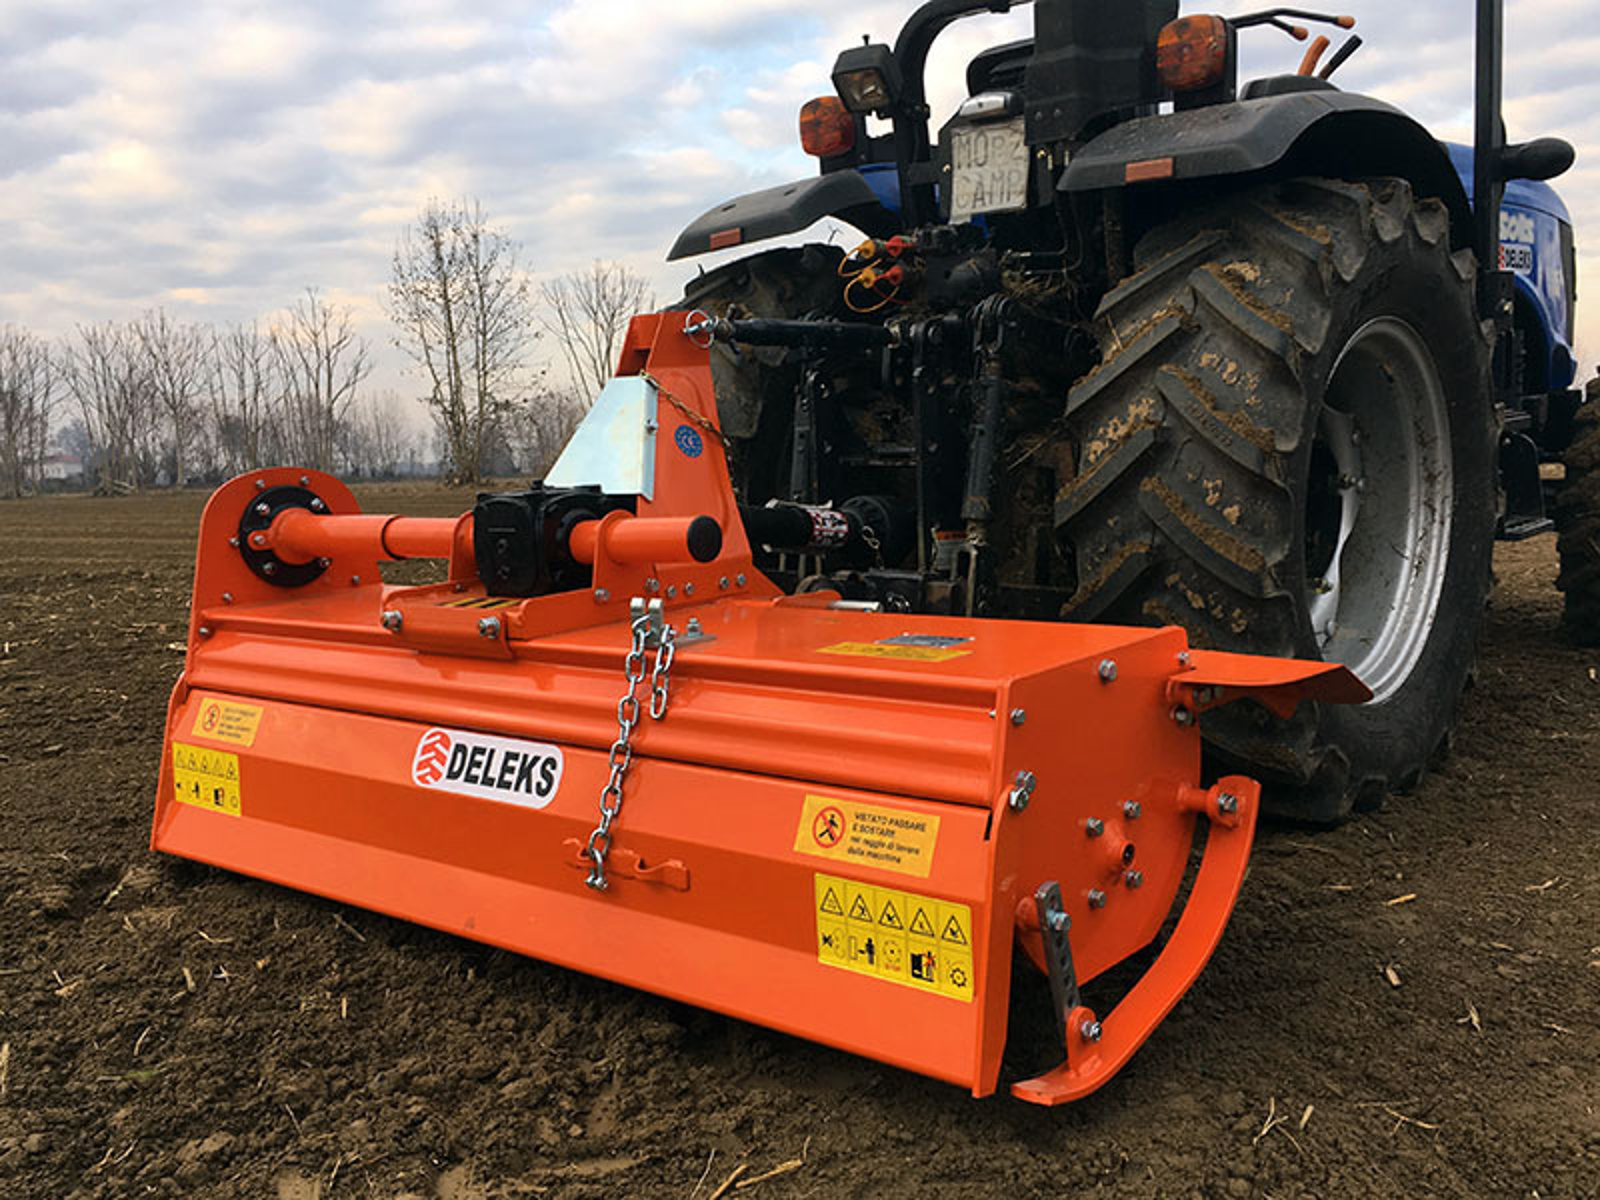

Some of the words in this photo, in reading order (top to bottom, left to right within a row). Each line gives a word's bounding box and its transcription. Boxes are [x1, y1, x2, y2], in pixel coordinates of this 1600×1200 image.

[446, 743, 557, 797] DELEKS
[854, 811, 887, 825] VIETATO
[888, 817, 926, 832] PASSARE
[860, 824, 895, 838] SOSTARE
